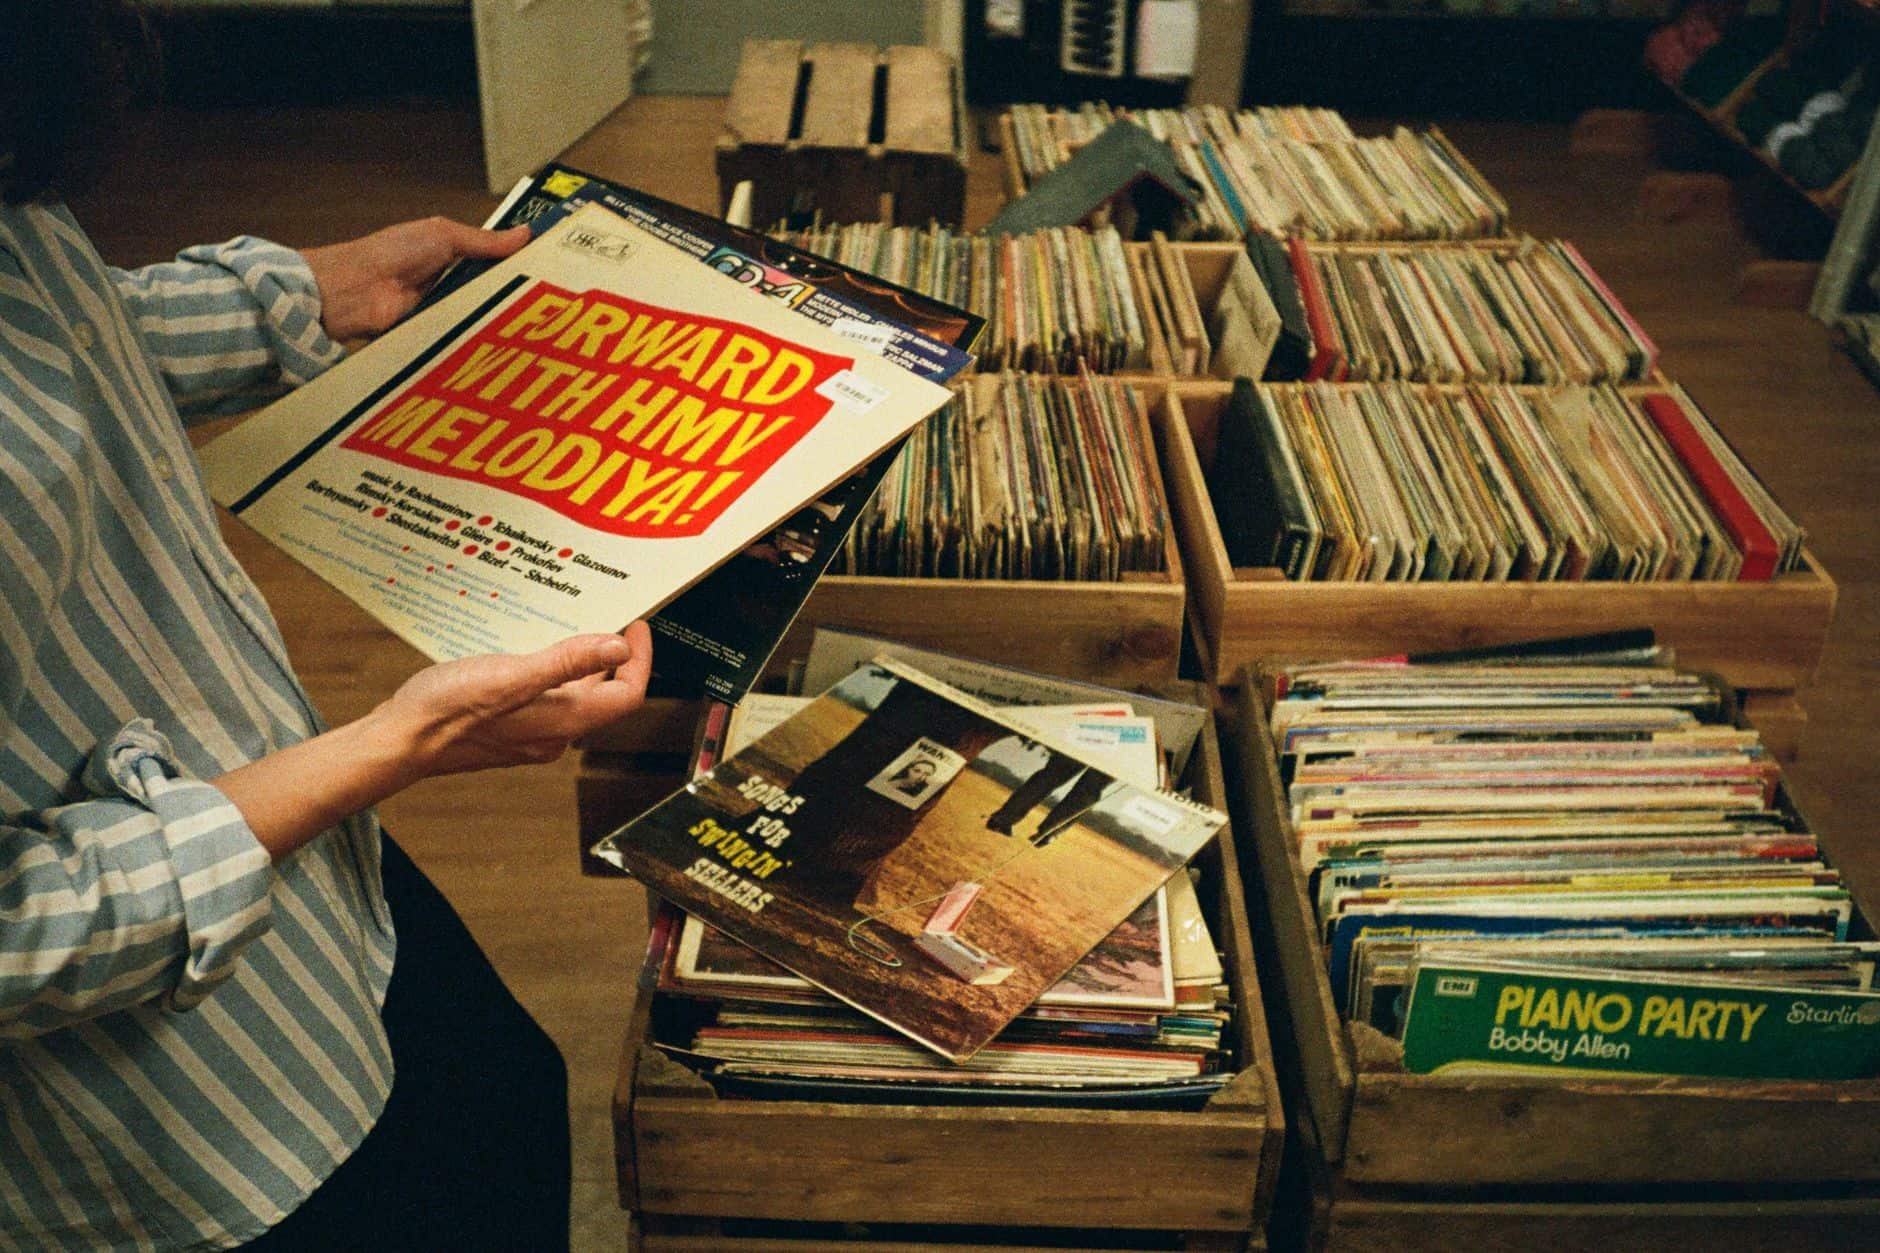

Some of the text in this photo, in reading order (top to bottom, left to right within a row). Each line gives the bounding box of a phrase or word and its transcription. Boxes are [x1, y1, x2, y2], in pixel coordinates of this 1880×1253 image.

[497, 293, 815, 406] FORWARD
[440, 342, 797, 468] WITH HMV
[361, 394, 745, 527] MELODIYA!
[355, 482, 445, 524] Rimsky-Korsakov
[460, 526, 494, 545] Glière
[511, 546, 566, 573] Prokofiev
[361, 470, 631, 580] music by Rachmaninov Tchaikovsky Glazounov
[386, 512, 461, 550] Shostakovitch
[478, 550, 510, 569] Bizet
[524, 569, 582, 598] Shchedrin
[737, 775, 806, 815] SONGS
[746, 815, 791, 848] FOR
[683, 858, 775, 913] SELLERS
[1489, 1026, 1631, 1063] Bobby Allen
[1494, 984, 1633, 1033] PIANO
[1638, 995, 1768, 1042] PARTY
[1786, 1000, 1873, 1025] Starlin
